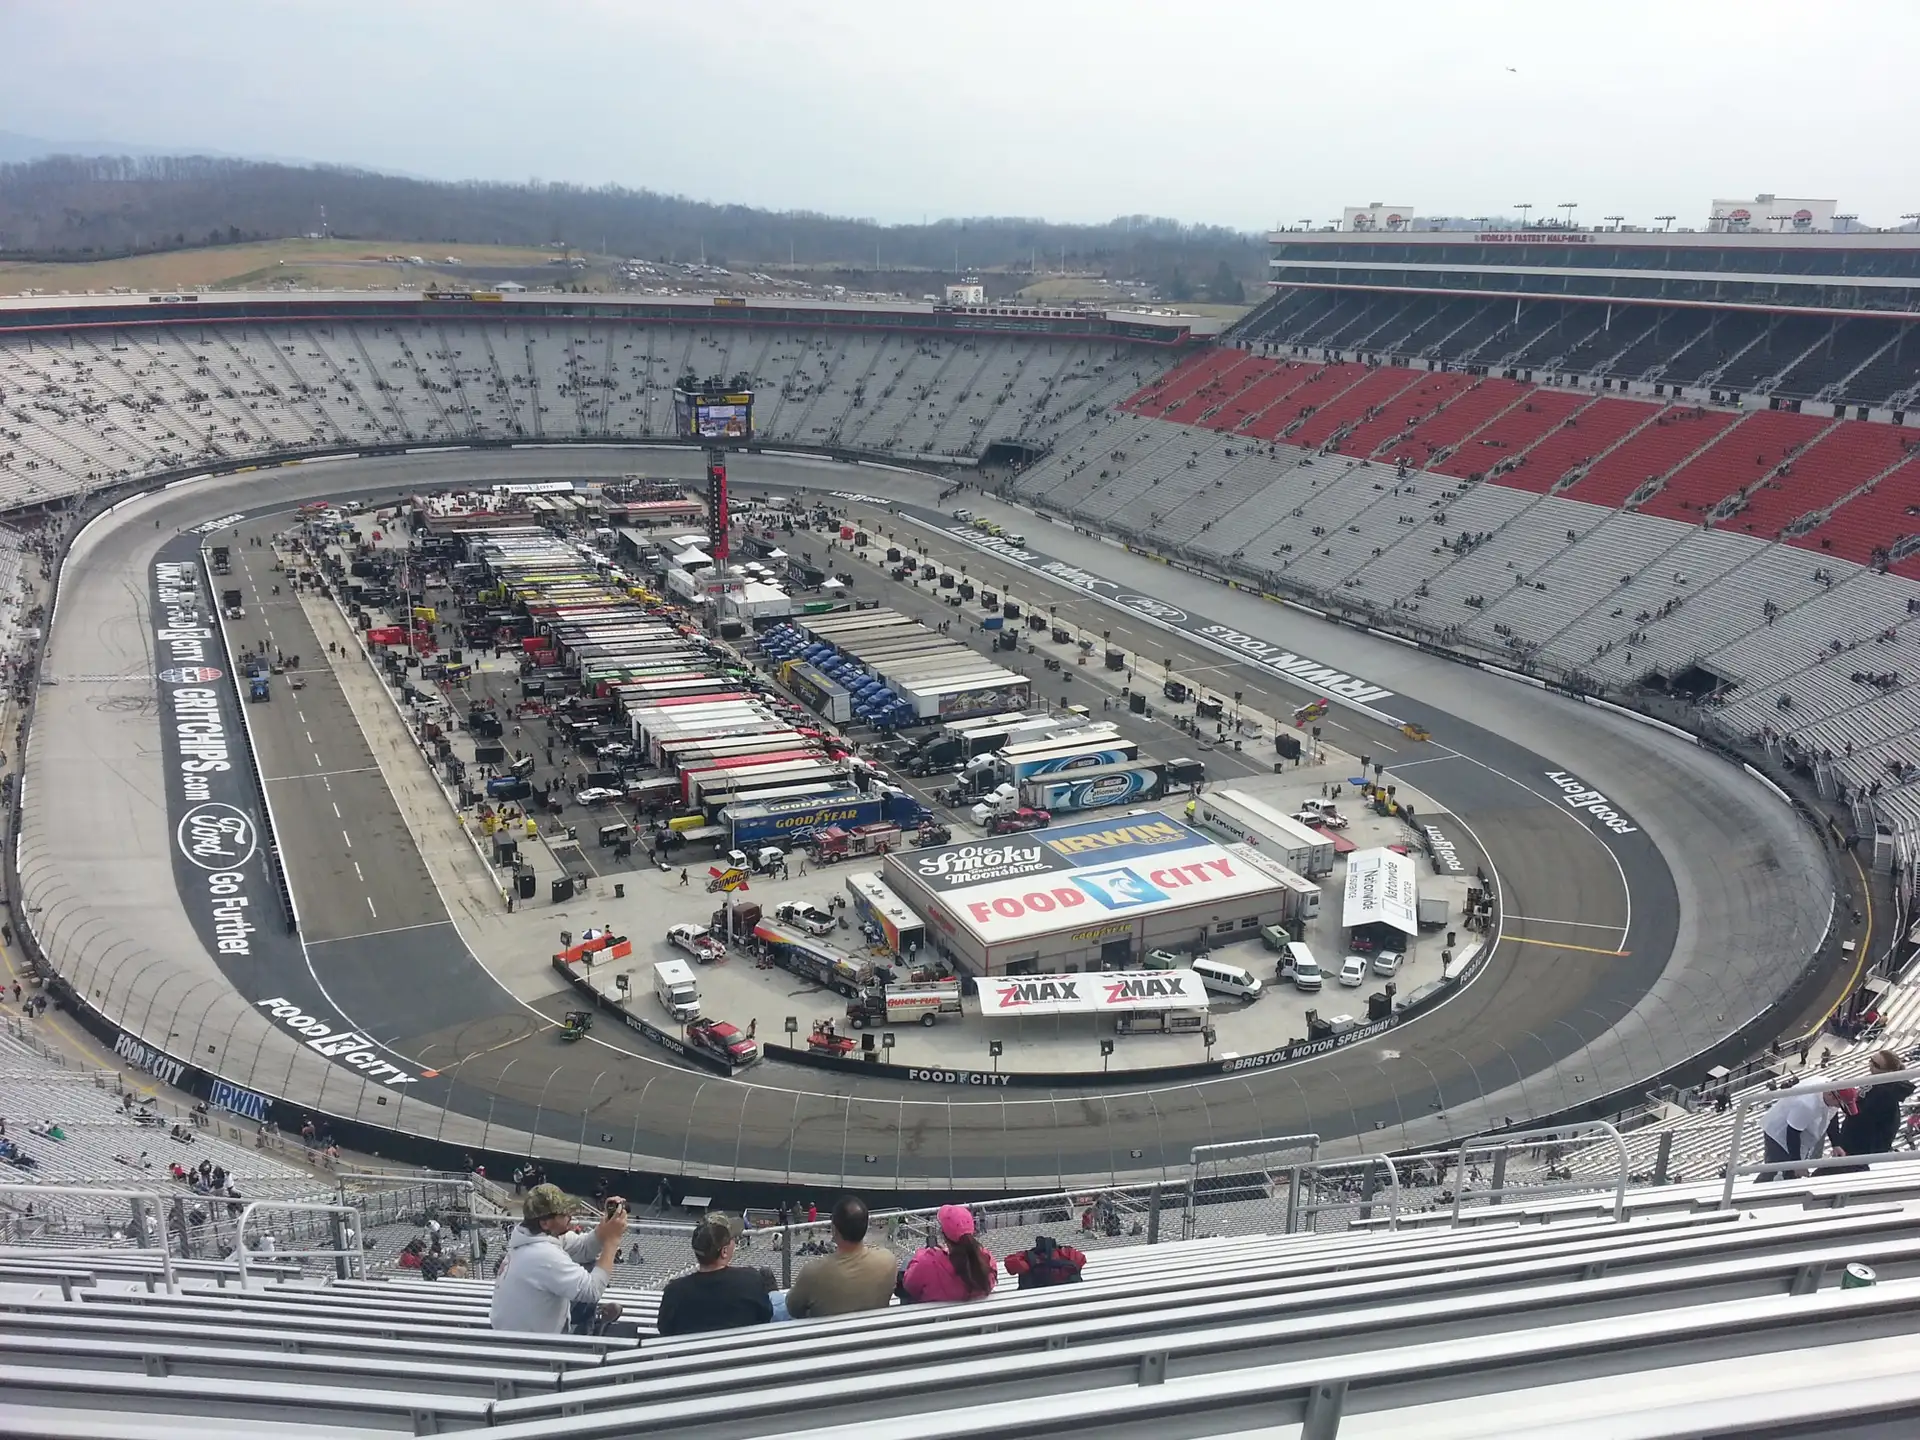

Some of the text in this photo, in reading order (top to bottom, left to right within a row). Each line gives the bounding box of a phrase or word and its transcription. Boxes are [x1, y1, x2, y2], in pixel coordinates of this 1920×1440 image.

[1481, 234, 1588, 243] WORLD'S FASTEST HALF-MILE
[945, 526, 1039, 562] FOOD CITY
[170, 640, 205, 662] CITY
[1201, 625, 1279, 656] TOOLS
[1263, 652, 1395, 703] IRWIN
[172, 687, 232, 801] GRITCHIPS.com
[769, 796, 857, 812] GOODYEAR
[775, 809, 857, 829] GOODYEAR
[1544, 771, 1638, 834] FOOD CITY
[1047, 821, 1178, 855] IRWIN
[1211, 813, 1259, 847] Forward Air
[918, 845, 1041, 876] Smoky
[958, 846, 1000, 858] Ole
[1424, 824, 1465, 871] FOOD CITY
[711, 871, 750, 891] SUNOCO
[945, 862, 1053, 885] Moonshine
[967, 887, 1085, 923] FOOD
[1149, 858, 1236, 889] CITY
[208, 872, 257, 956] Go Further
[1071, 923, 1132, 941] GOODYEAR
[257, 997, 418, 1086] FOOD CITY
[626, 1015, 642, 1031] BUILT
[661, 1036, 684, 1055] TOUGH
[1234, 1049, 1287, 1070] BRISTOL
[1292, 1038, 1334, 1059] MOTOR
[1338, 1018, 1391, 1046] SPEEDWAY
[113, 1033, 185, 1086] FOOD CITY
[909, 1069, 1011, 1086] FOOD CITY
[210, 1080, 271, 1121] IRWIN
